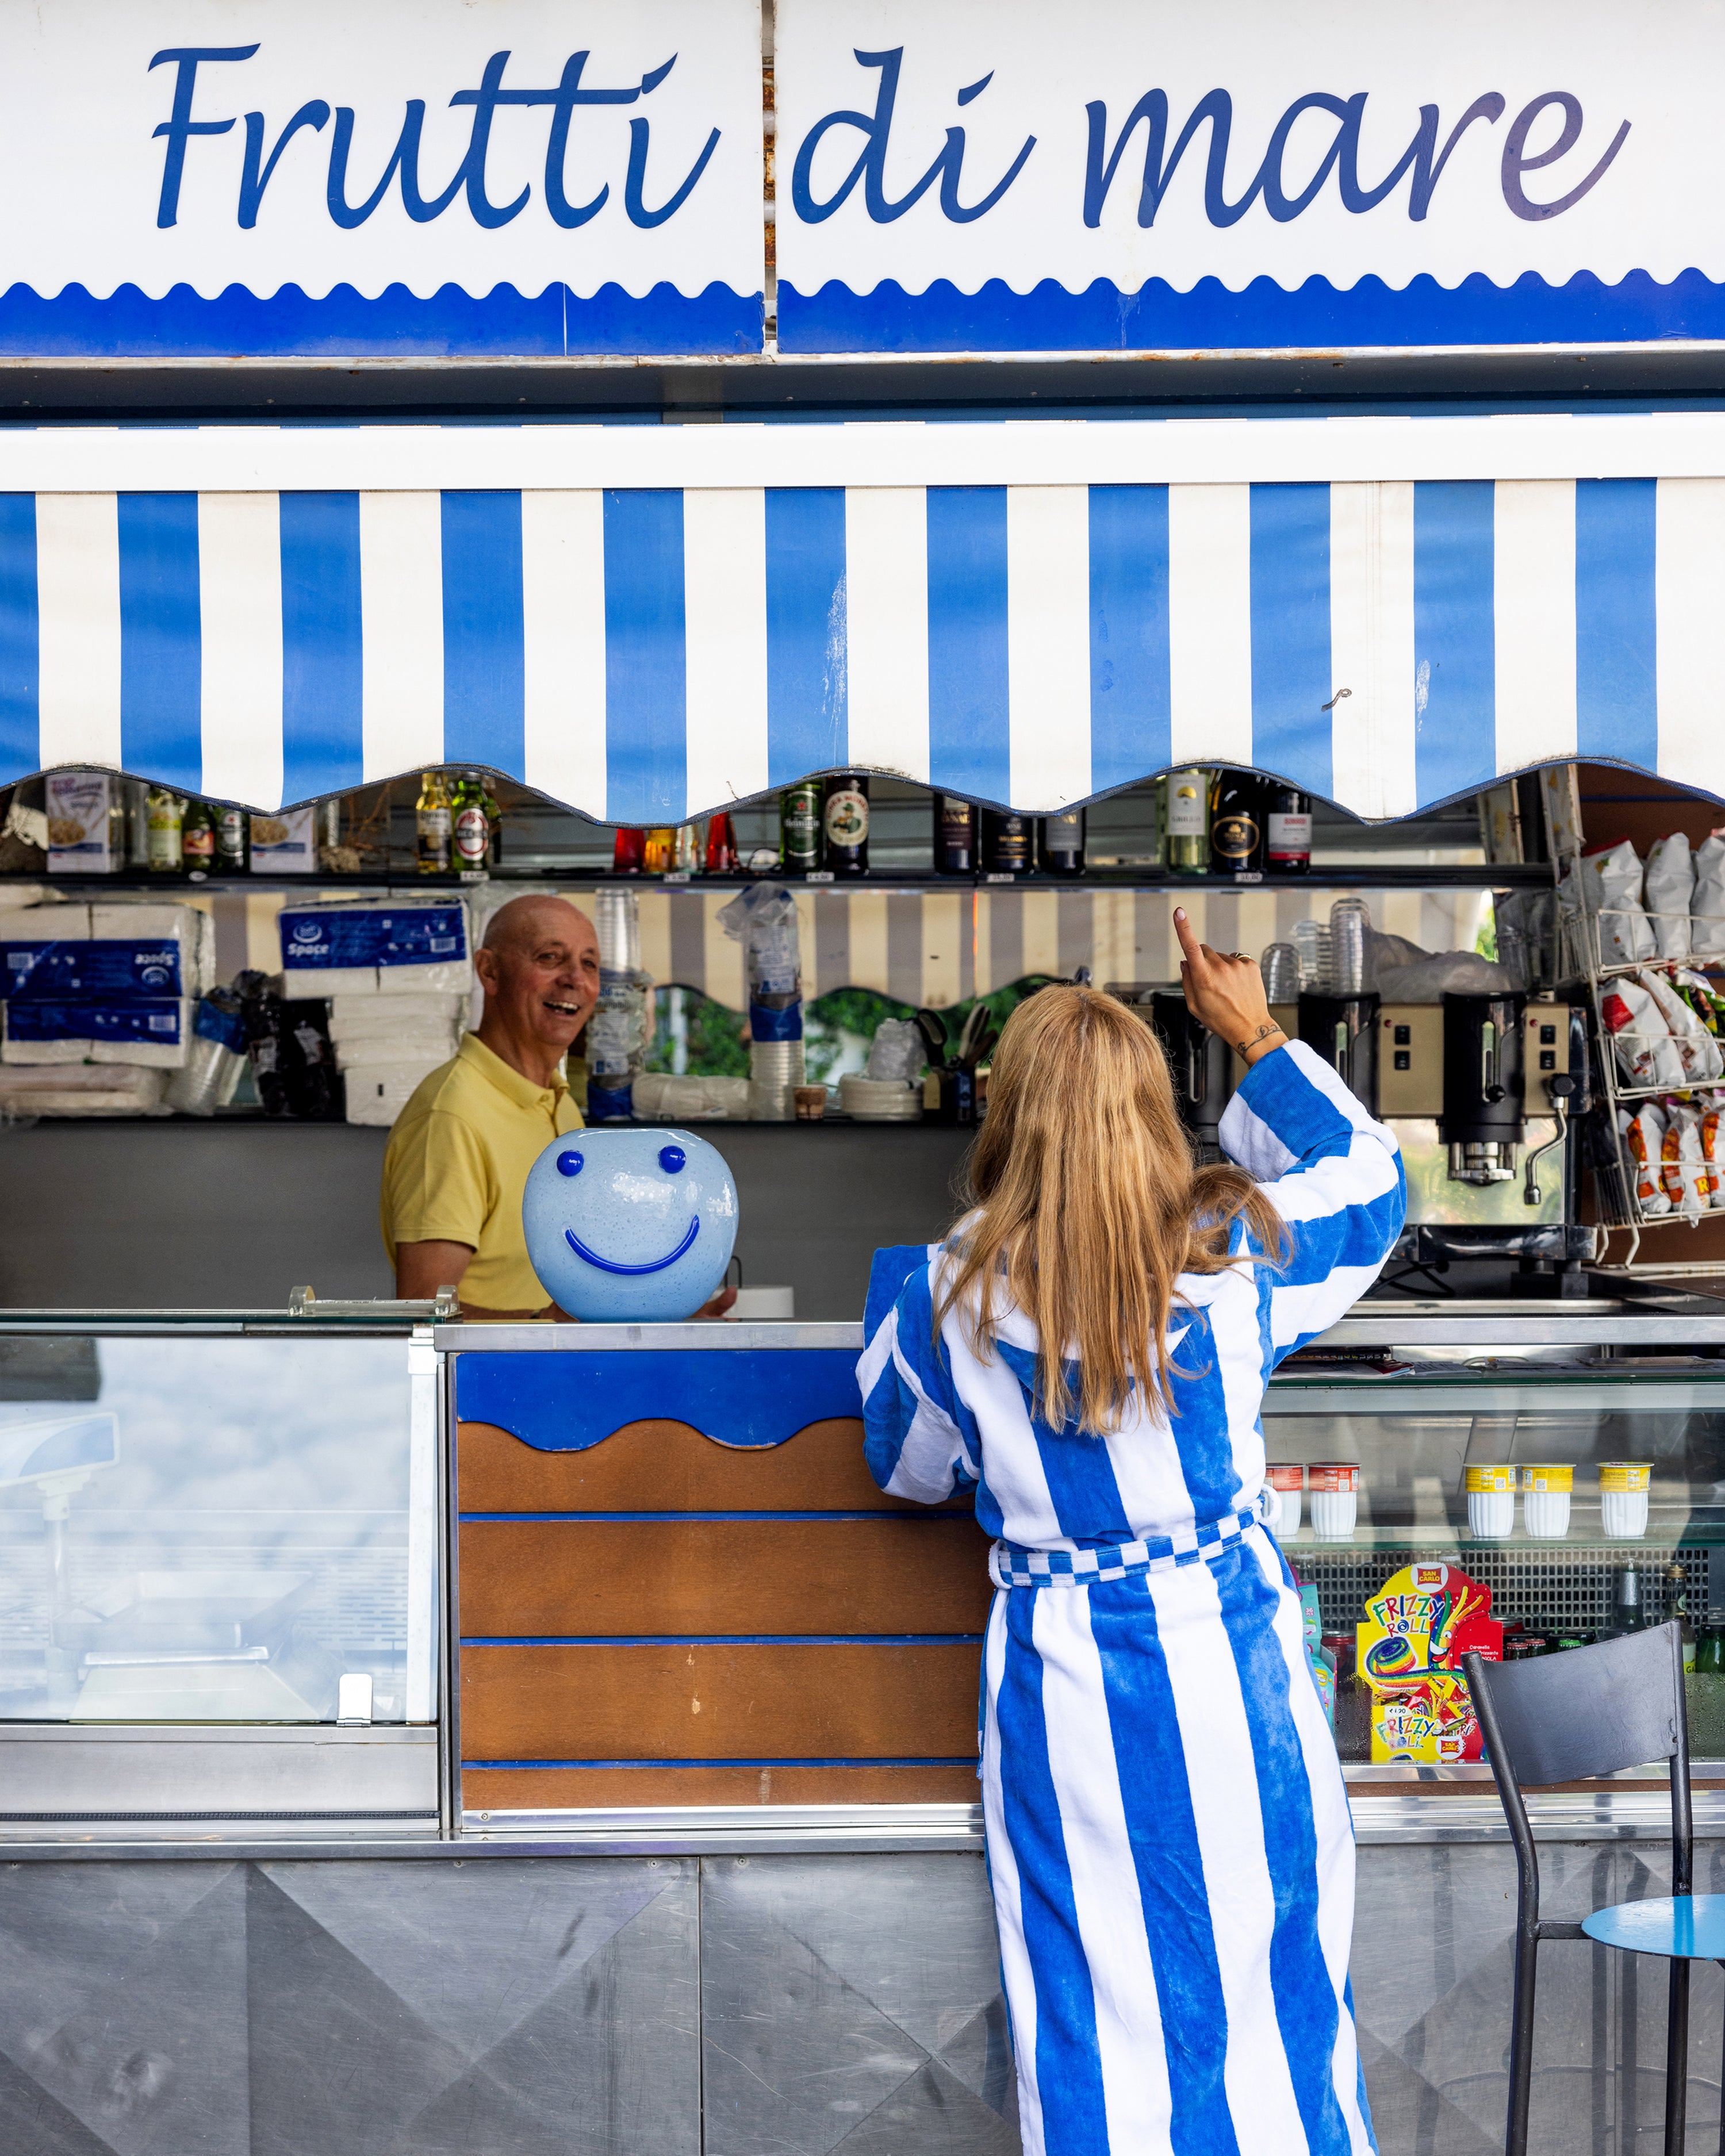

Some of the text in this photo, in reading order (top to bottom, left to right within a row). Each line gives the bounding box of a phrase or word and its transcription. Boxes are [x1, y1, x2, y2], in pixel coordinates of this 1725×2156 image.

[148, 43, 1631, 229] Frutti di mare
[288, 943, 329, 957] Space
[1373, 1594, 1444, 1626] FRIZZY
[1387, 1619, 1429, 1637] ROLL
[1376, 1717, 1435, 1743] FRIZZY
